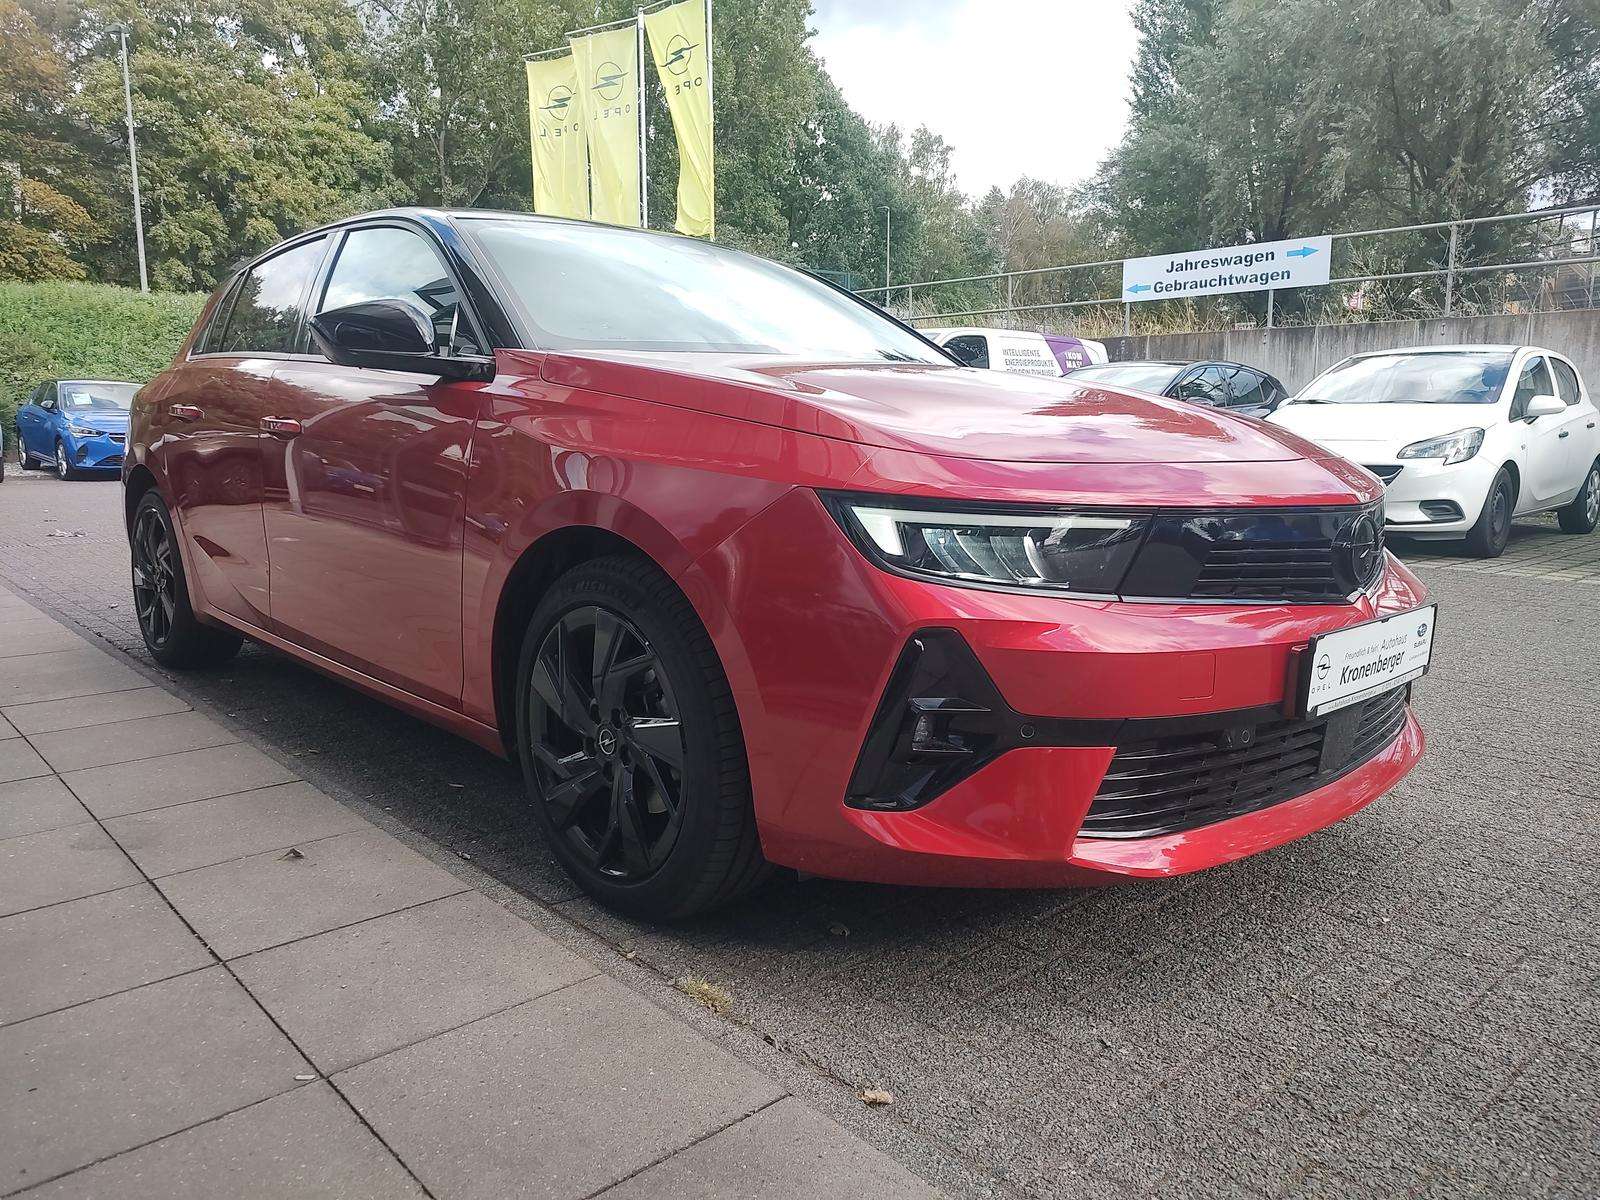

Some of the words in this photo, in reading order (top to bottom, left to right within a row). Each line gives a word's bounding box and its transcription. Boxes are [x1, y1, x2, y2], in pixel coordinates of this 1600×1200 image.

[1166, 249, 1275, 274] Jahreswagen
[1153, 268, 1291, 294] Gebrauchtwagen
[1380, 633, 1408, 650] Autohaus
[1339, 650, 1405, 686] Kronenberger
[1311, 682, 1332, 694] OPEL
